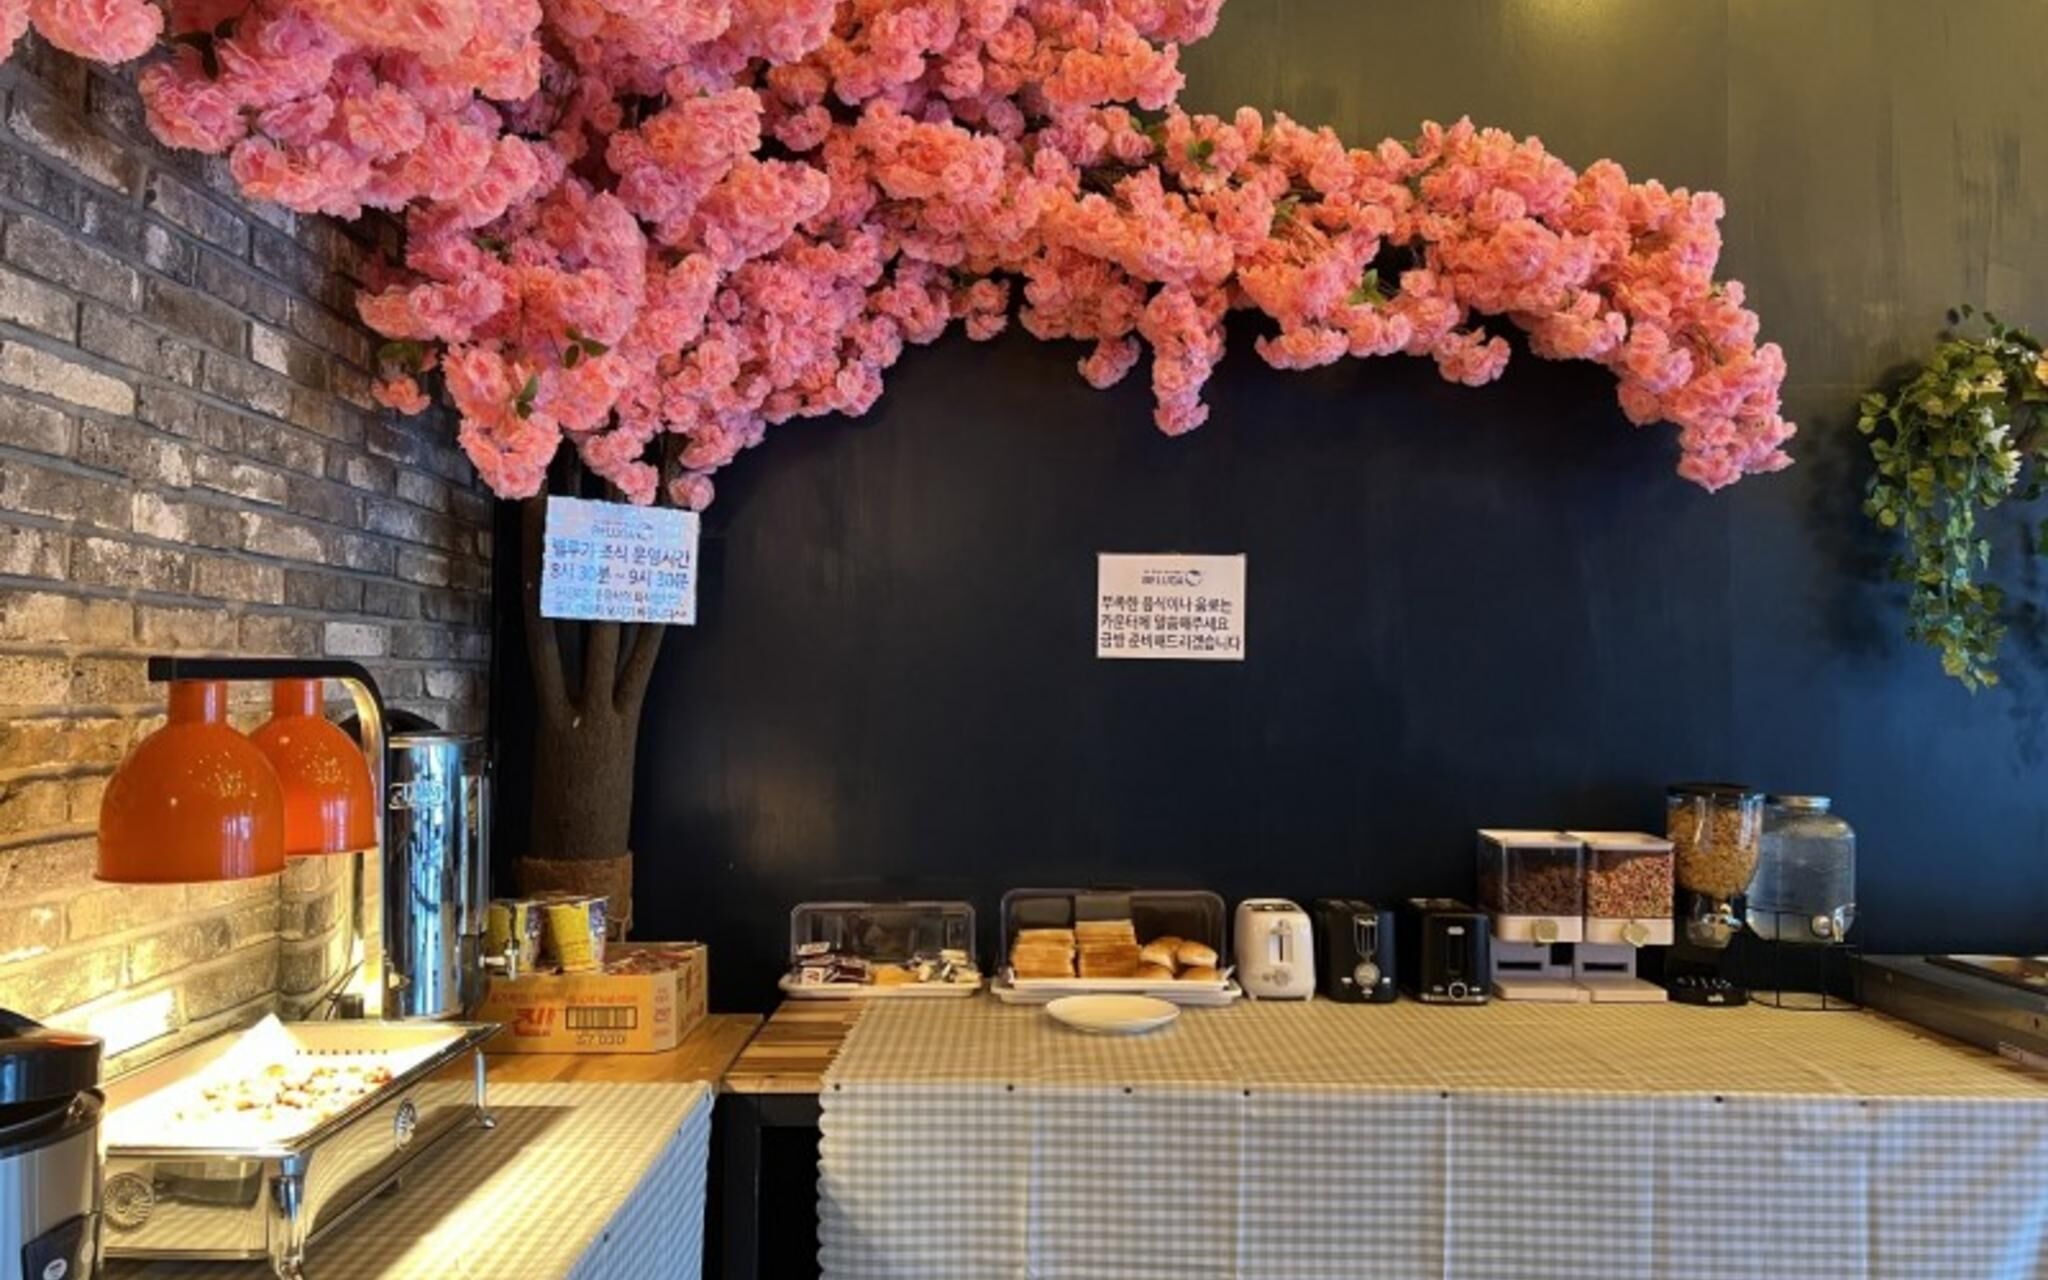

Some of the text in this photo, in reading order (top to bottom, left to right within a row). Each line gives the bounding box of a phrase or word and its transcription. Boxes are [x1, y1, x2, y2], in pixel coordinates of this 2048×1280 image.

[600, 545, 628, 563] 조식
[551, 563, 575, 580] 8시
[628, 568, 651, 587] 9시
[1102, 595, 1139, 613] 부족한
[1101, 613, 1230, 632] 카운터에 말씀해주세요
